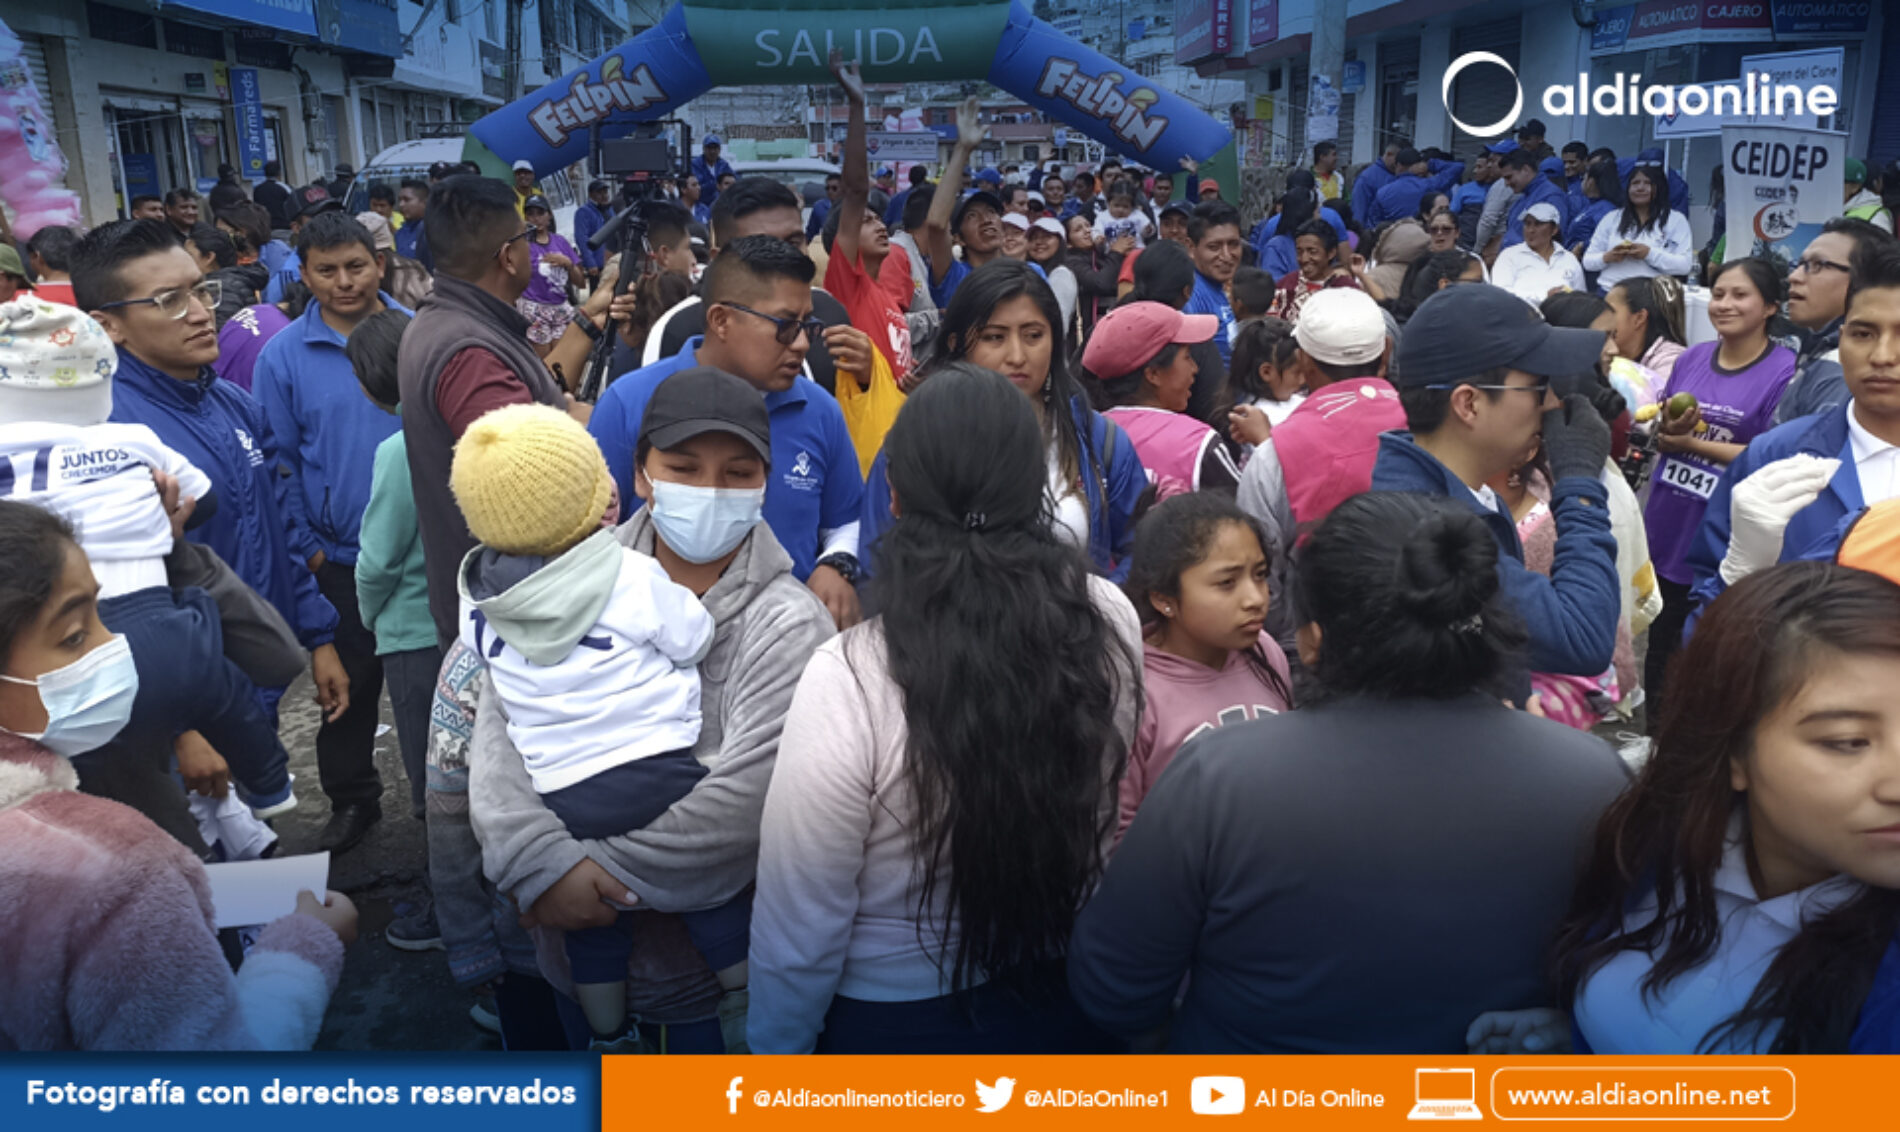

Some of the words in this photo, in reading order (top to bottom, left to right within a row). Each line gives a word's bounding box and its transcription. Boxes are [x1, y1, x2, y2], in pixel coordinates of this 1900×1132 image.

[1707, 5, 1762, 18] CAJERO
[755, 26, 943, 66] SALIDA
[242, 71, 260, 152] Farmareds
[1731, 140, 1828, 181] CEIDEP
[60, 449, 129, 470] JUNTOS
[61, 463, 117, 479] CRECEMOS
[1666, 463, 1715, 493] 1041
